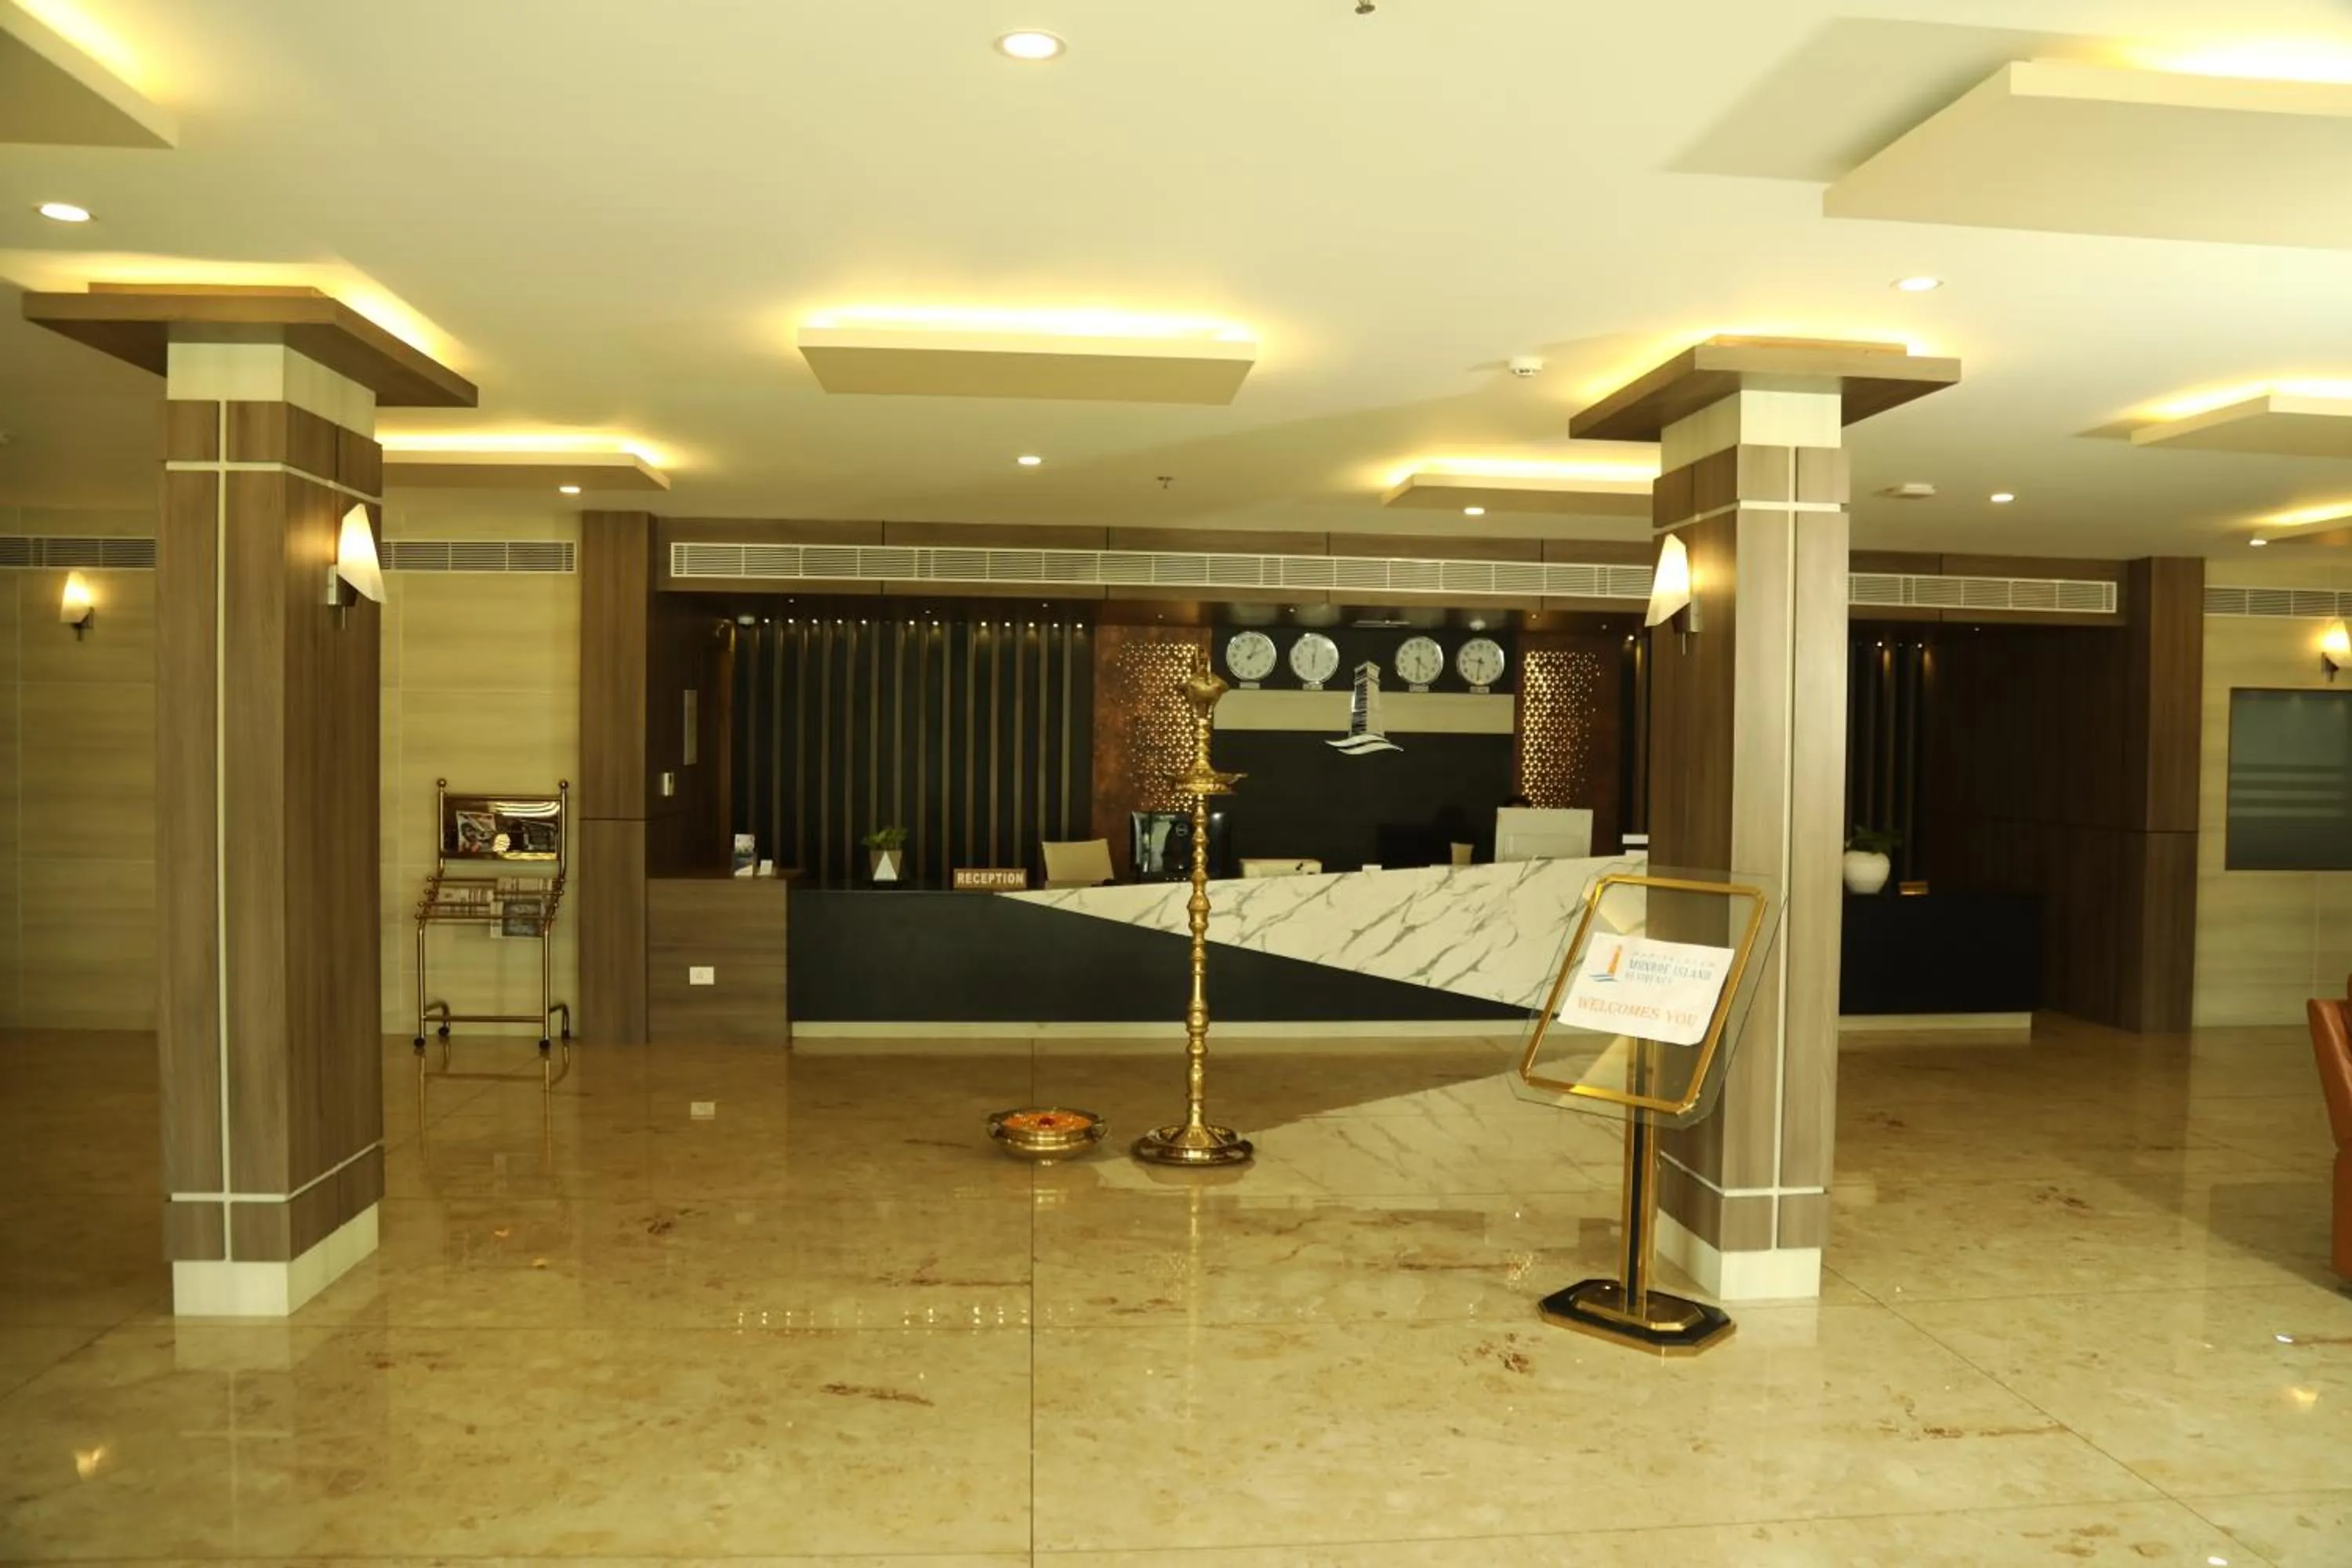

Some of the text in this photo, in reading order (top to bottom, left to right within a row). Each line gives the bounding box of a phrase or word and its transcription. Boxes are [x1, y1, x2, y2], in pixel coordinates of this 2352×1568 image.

[956, 872, 1024, 884] RECEPTION
[1577, 996, 1698, 1027] WELCOMES YOU
